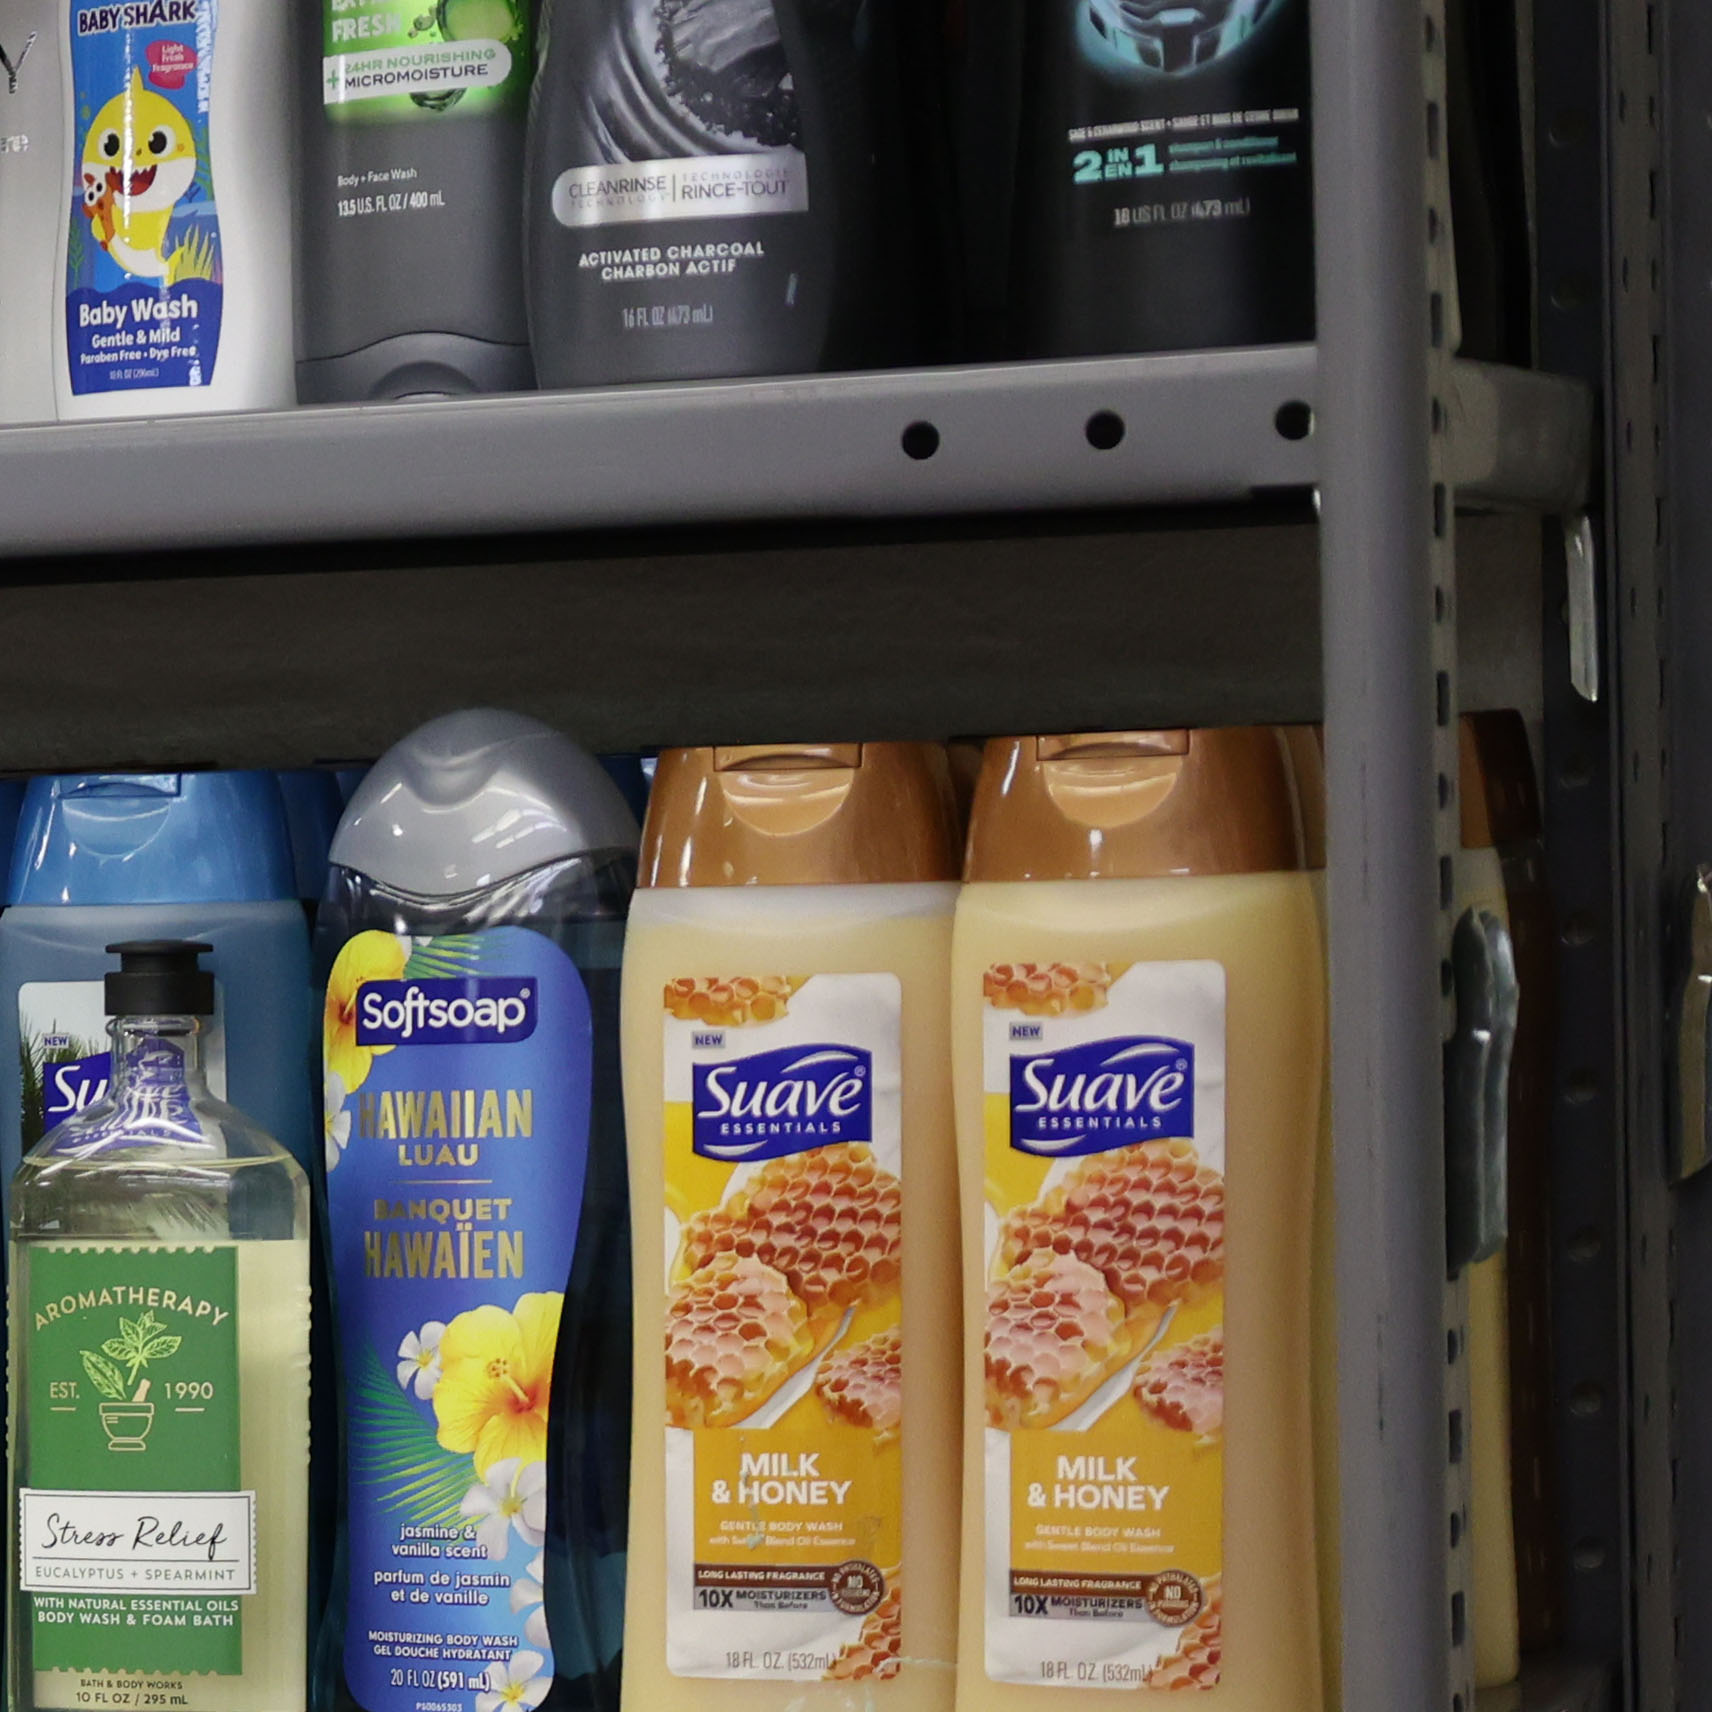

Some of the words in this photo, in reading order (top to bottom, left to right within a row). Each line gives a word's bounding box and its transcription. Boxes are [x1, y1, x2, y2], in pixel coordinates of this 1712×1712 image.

[385, 48, 497, 67] NOURISHING
[344, 63, 488, 88] MICROMOISTURE
[569, 174, 667, 197] CLEANRINSE
[579, 246, 661, 269] ACTIVATED
[667, 240, 765, 259] CHARCOAL
[601, 262, 680, 280] CHARBON
[80, 300, 128, 329] Baby
[132, 294, 198, 322] Wash
[92, 331, 134, 348] Gentle
[149, 326, 180, 343] Mild
[362, 985, 526, 1037] Softsoap
[698, 1066, 863, 1119] Suave
[1014, 1058, 1185, 1113] Suave
[359, 1089, 533, 1139] HAWAIIAN
[1038, 1116, 1162, 1129] ESSENTIALS
[721, 1121, 841, 1134] ESSENTIALS
[398, 1143, 479, 1167] LUAU
[374, 1197, 513, 1222] BANQUET
[33, 1286, 231, 1331] AROMATHERAPY
[164, 1382, 214, 1399] 1990
[741, 1452, 820, 1477] MILK
[1057, 1455, 1138, 1482] MILK
[738, 1480, 853, 1505] HONEY
[1054, 1484, 1170, 1511] HONEY
[42, 1513, 124, 1549] Stress
[132, 1515, 227, 1562] Relief
[400, 1523, 458, 1542] jasmine
[392, 1543, 440, 1558] vanilla
[445, 1545, 488, 1558] scent
[36, 1566, 124, 1580] EUCALYPTUS
[145, 1568, 236, 1581] SPEARMINT
[374, 1570, 424, 1585] parfum
[455, 1573, 511, 1590] jasmin
[68, 1598, 127, 1611] NATURAL
[130, 1599, 203, 1612] ESSENTIAL
[434, 1592, 489, 1605] vanille
[37, 1611, 75, 1624] BODY
[80, 1613, 121, 1625] WASH
[142, 1613, 187, 1626] FOAM
[193, 1613, 233, 1627] BATH
